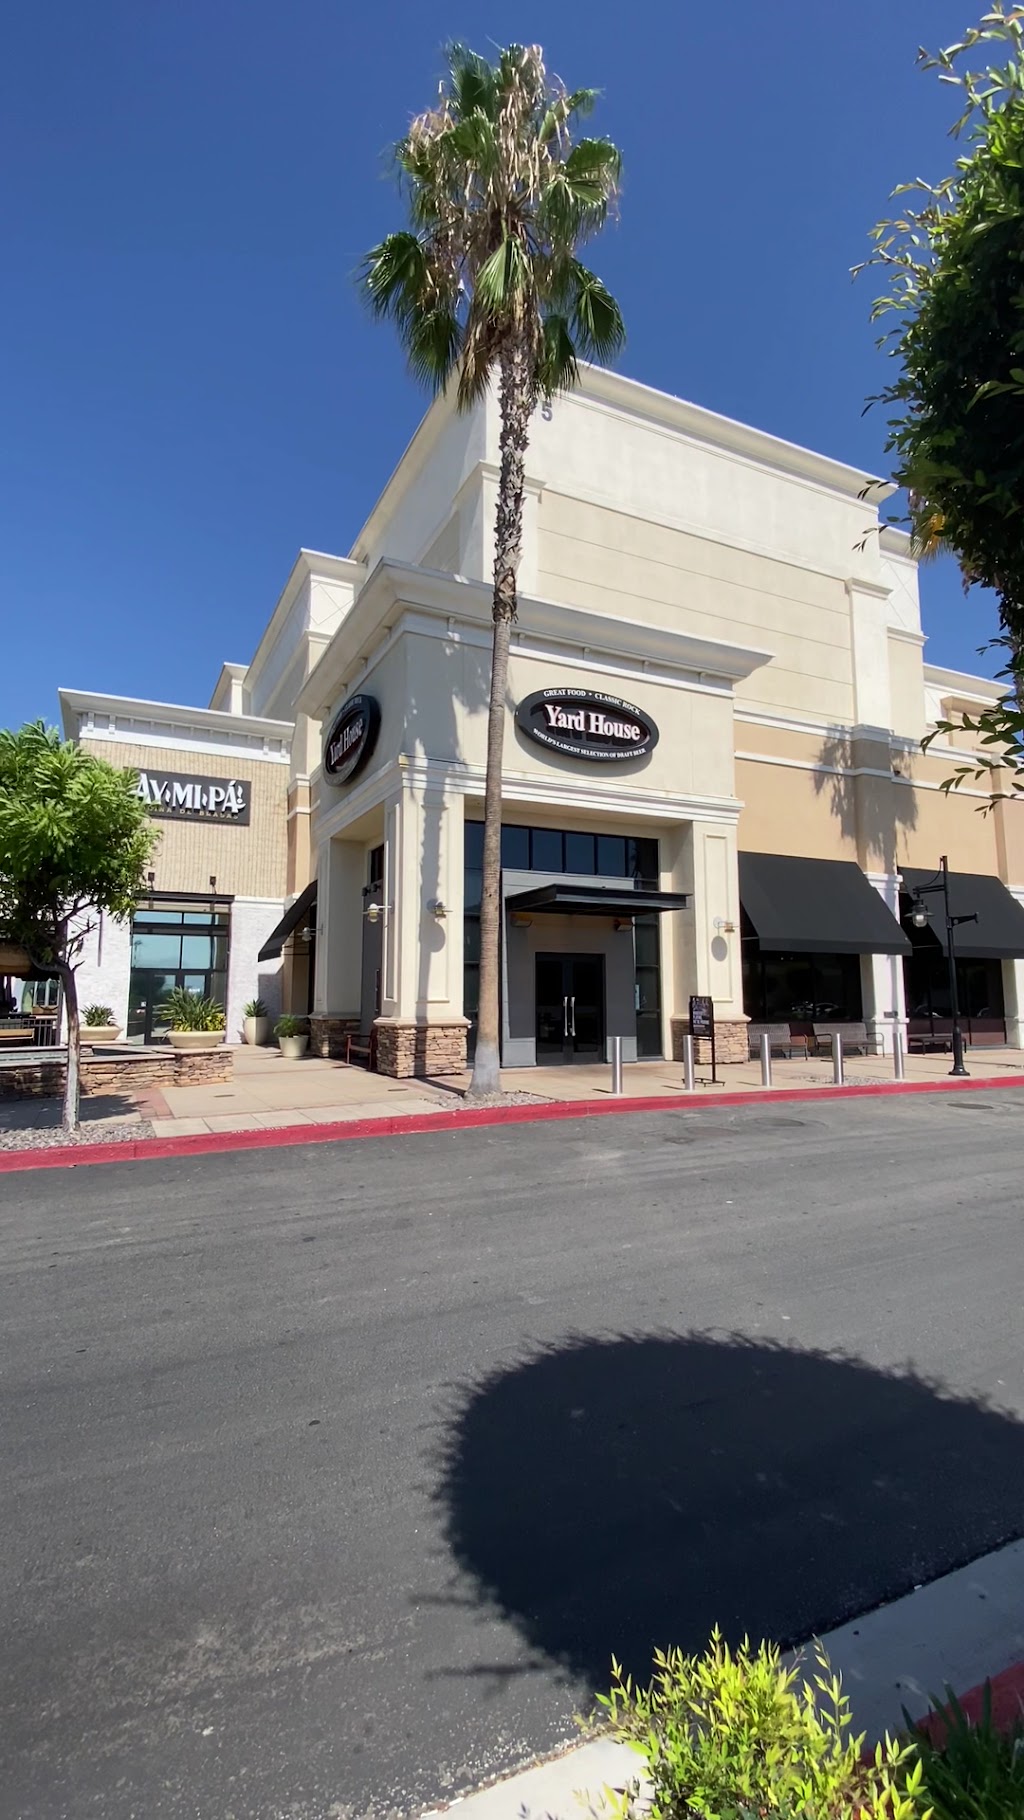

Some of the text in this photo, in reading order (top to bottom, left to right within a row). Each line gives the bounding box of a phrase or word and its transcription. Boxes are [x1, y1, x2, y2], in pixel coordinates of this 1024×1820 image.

[541, 400, 553, 422] 5
[543, 689, 641, 716] GREAT FOOD CLASSIC ROCK
[545, 704, 641, 741] Yard House
